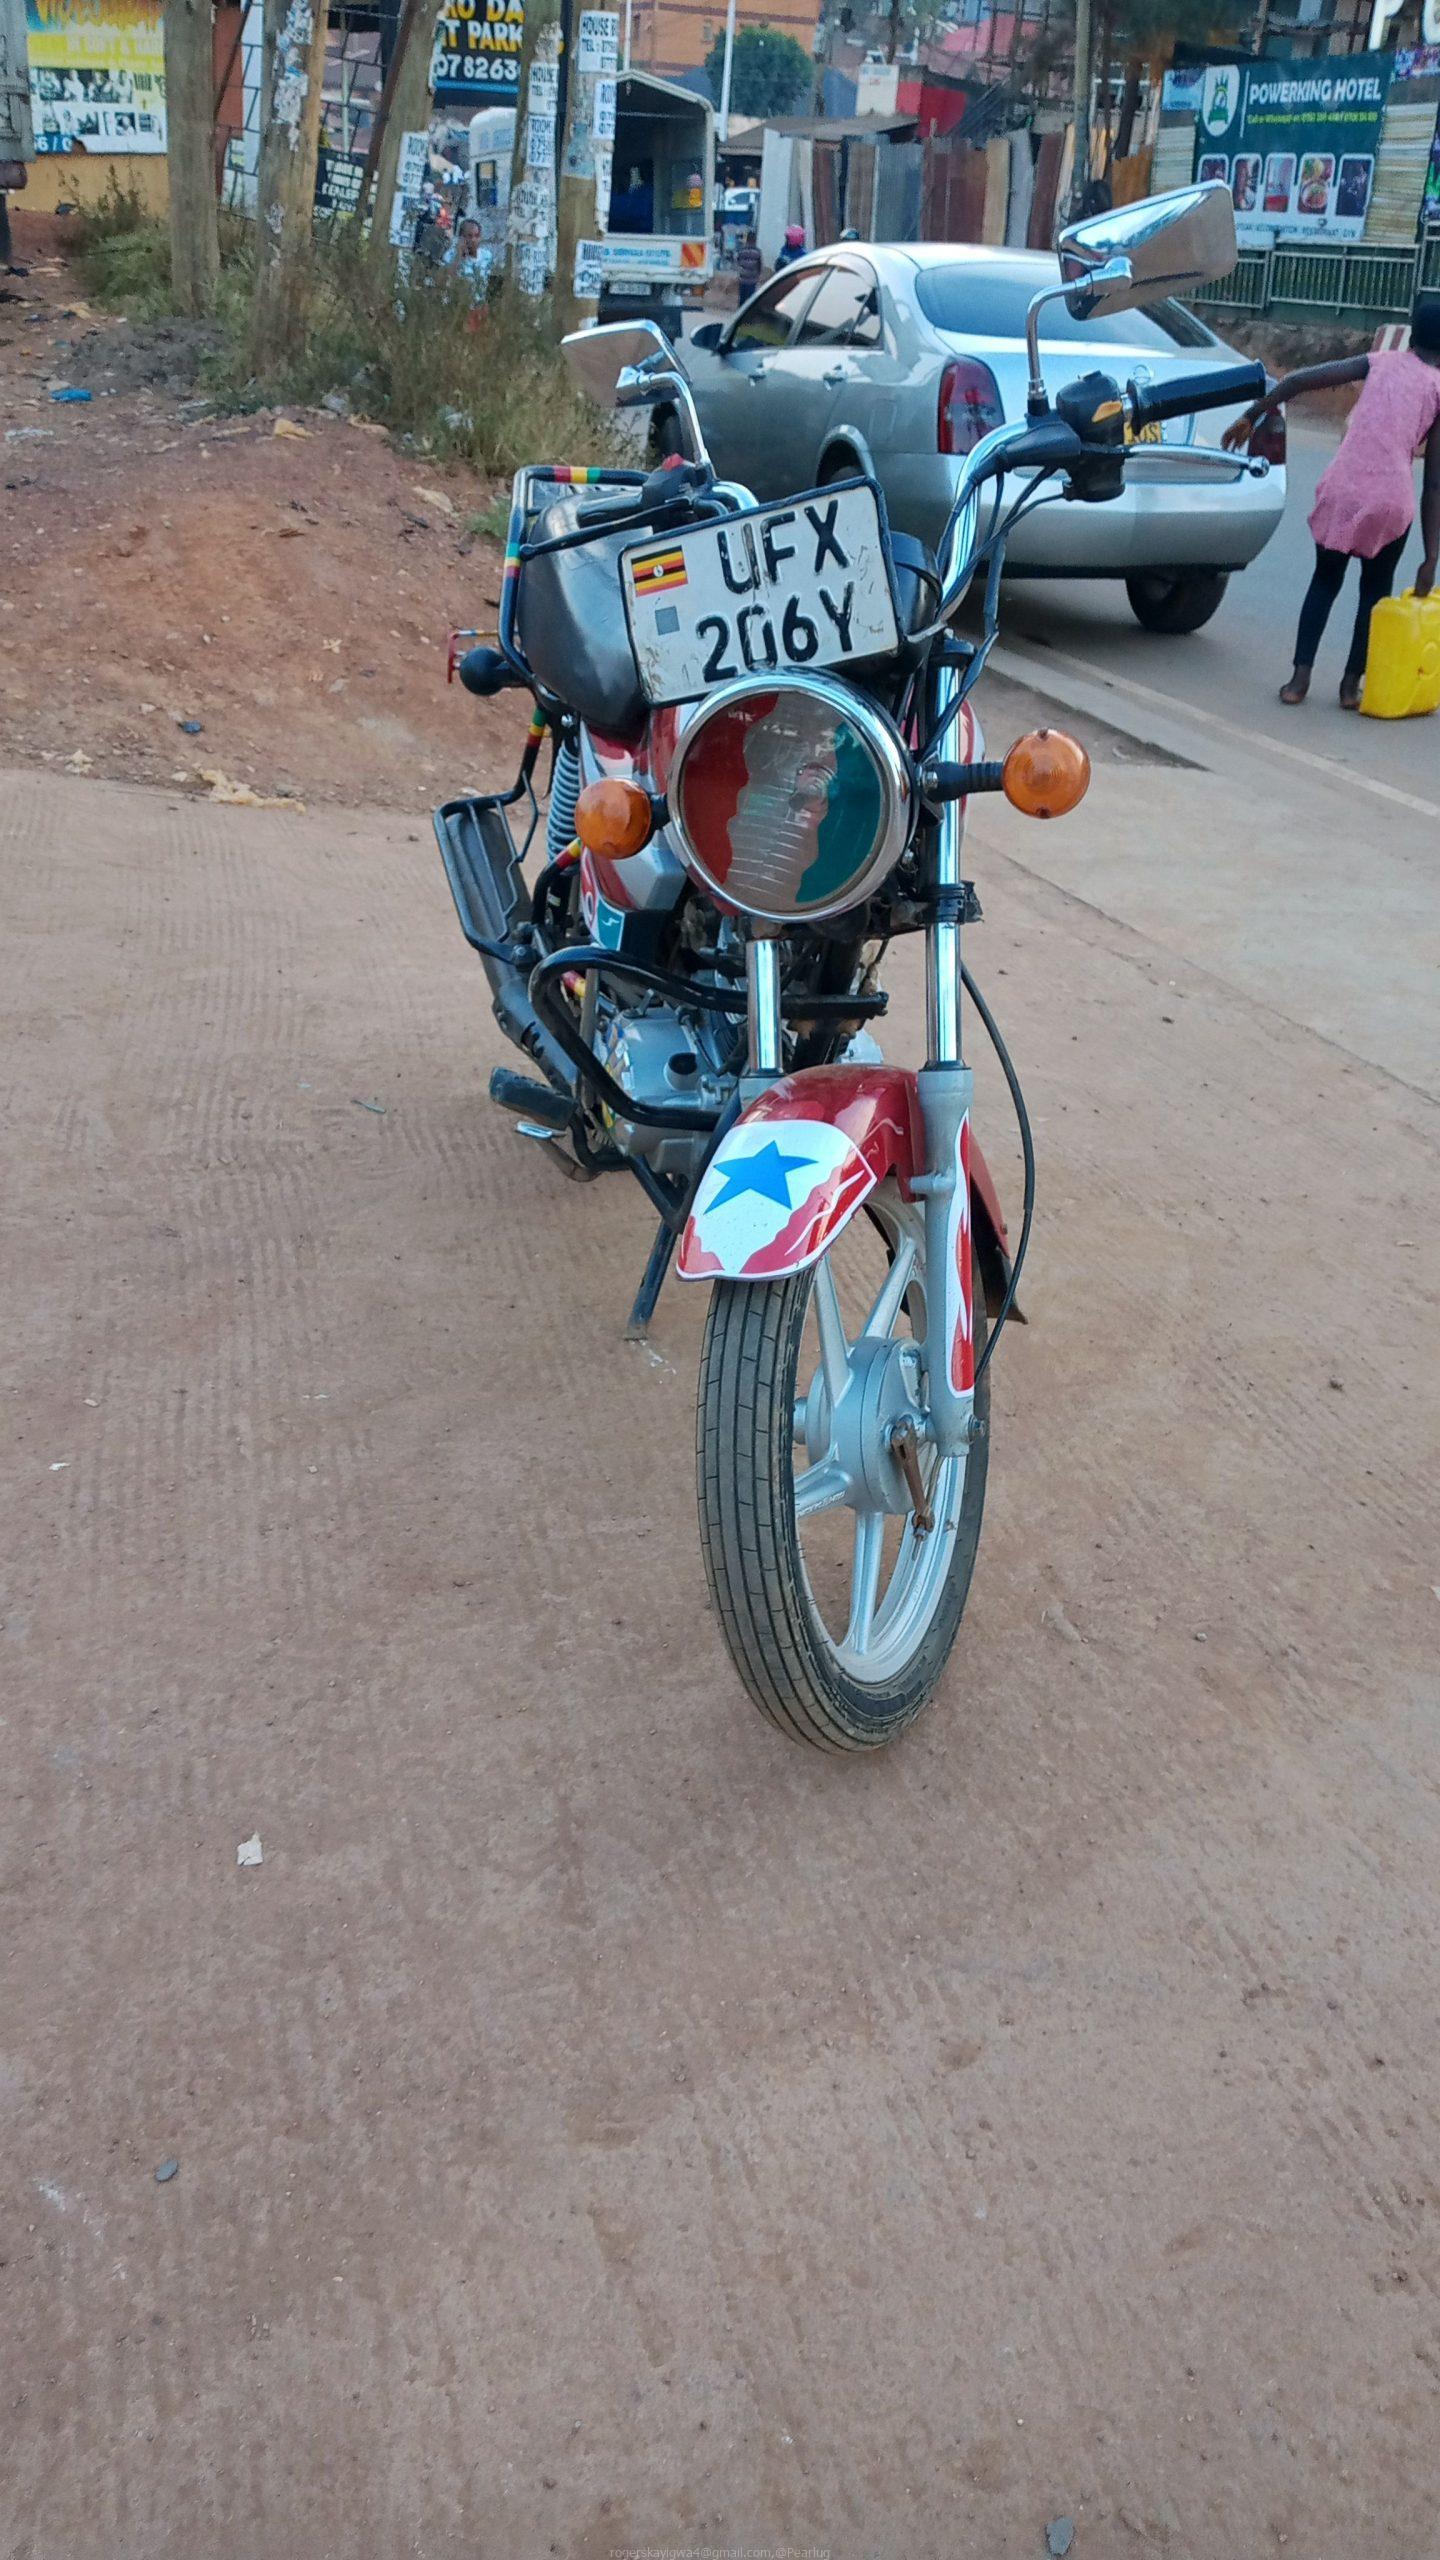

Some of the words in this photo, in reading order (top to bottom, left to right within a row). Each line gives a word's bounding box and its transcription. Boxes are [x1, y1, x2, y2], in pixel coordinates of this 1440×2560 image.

[1250, 80, 1332, 105] POWERKING
[1335, 78, 1382, 101] HOTEL
[717, 500, 850, 594] UFX
[696, 581, 854, 682] 206Y
